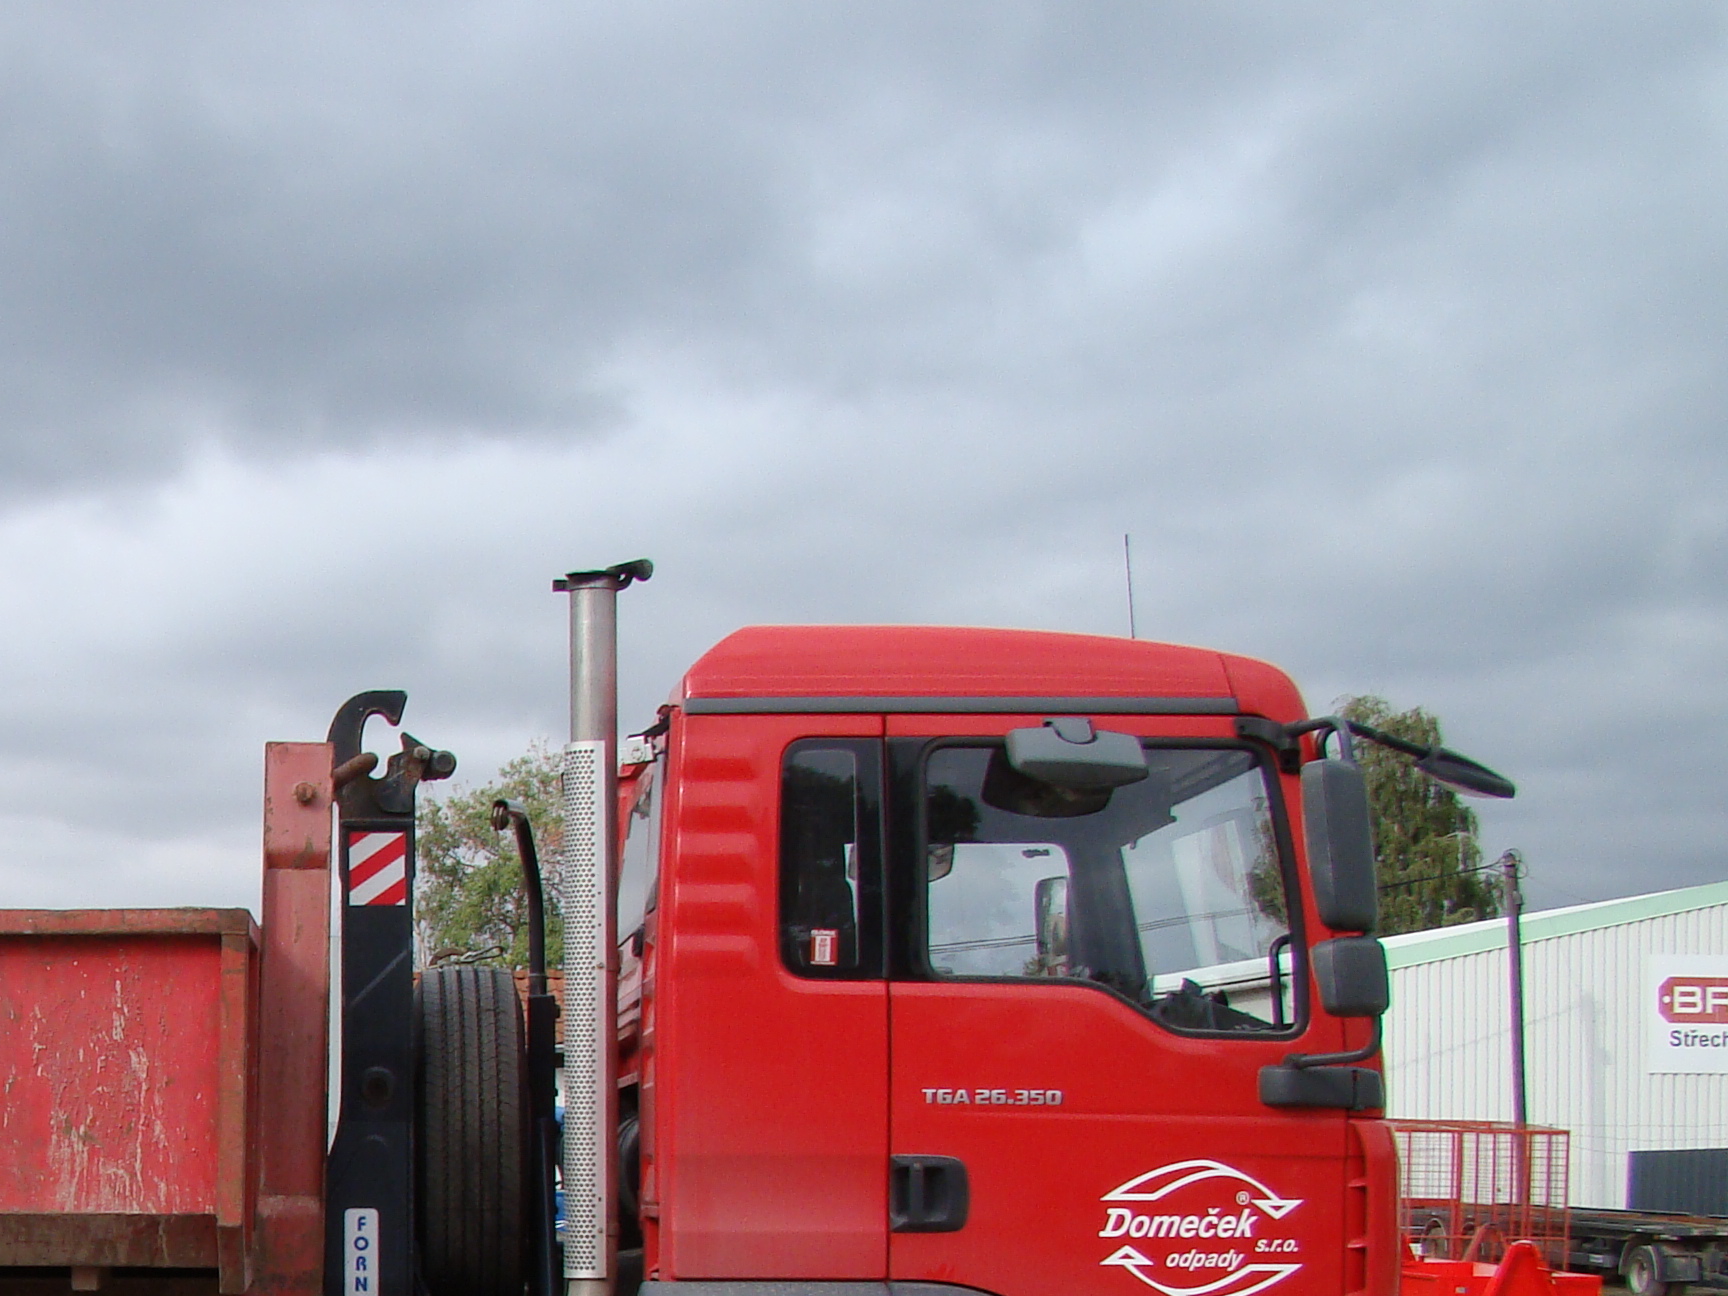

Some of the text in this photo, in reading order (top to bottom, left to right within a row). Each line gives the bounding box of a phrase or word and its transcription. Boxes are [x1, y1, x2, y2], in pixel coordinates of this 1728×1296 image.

[921, 1088, 1063, 1105] TGA 26.350
[1098, 1207, 1259, 1238] Domeček
[1254, 1238, 1299, 1253] s.r.o.
[1165, 1249, 1245, 1272] odpady
